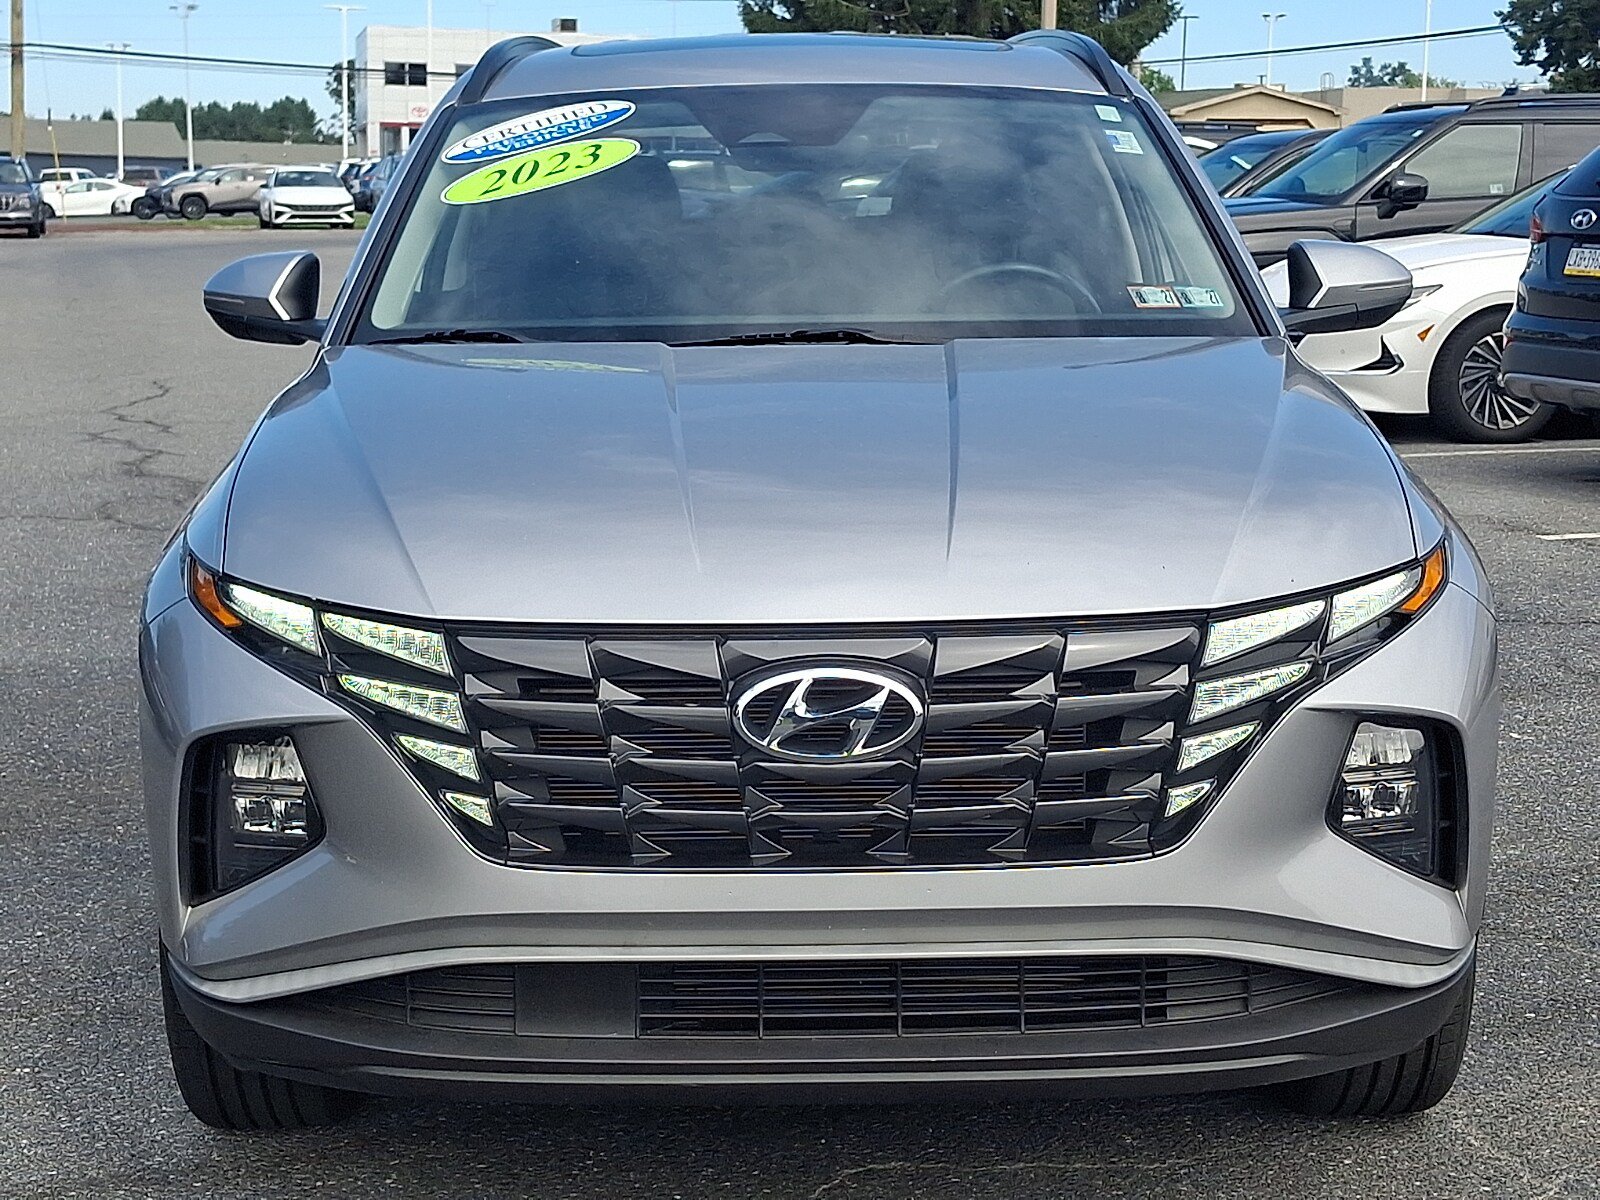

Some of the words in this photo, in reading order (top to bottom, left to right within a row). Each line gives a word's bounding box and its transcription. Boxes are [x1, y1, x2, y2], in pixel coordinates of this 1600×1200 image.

[463, 103, 608, 149] CERTIFIED
[496, 117, 593, 152] VEHICLE
[479, 144, 602, 196] 2023
